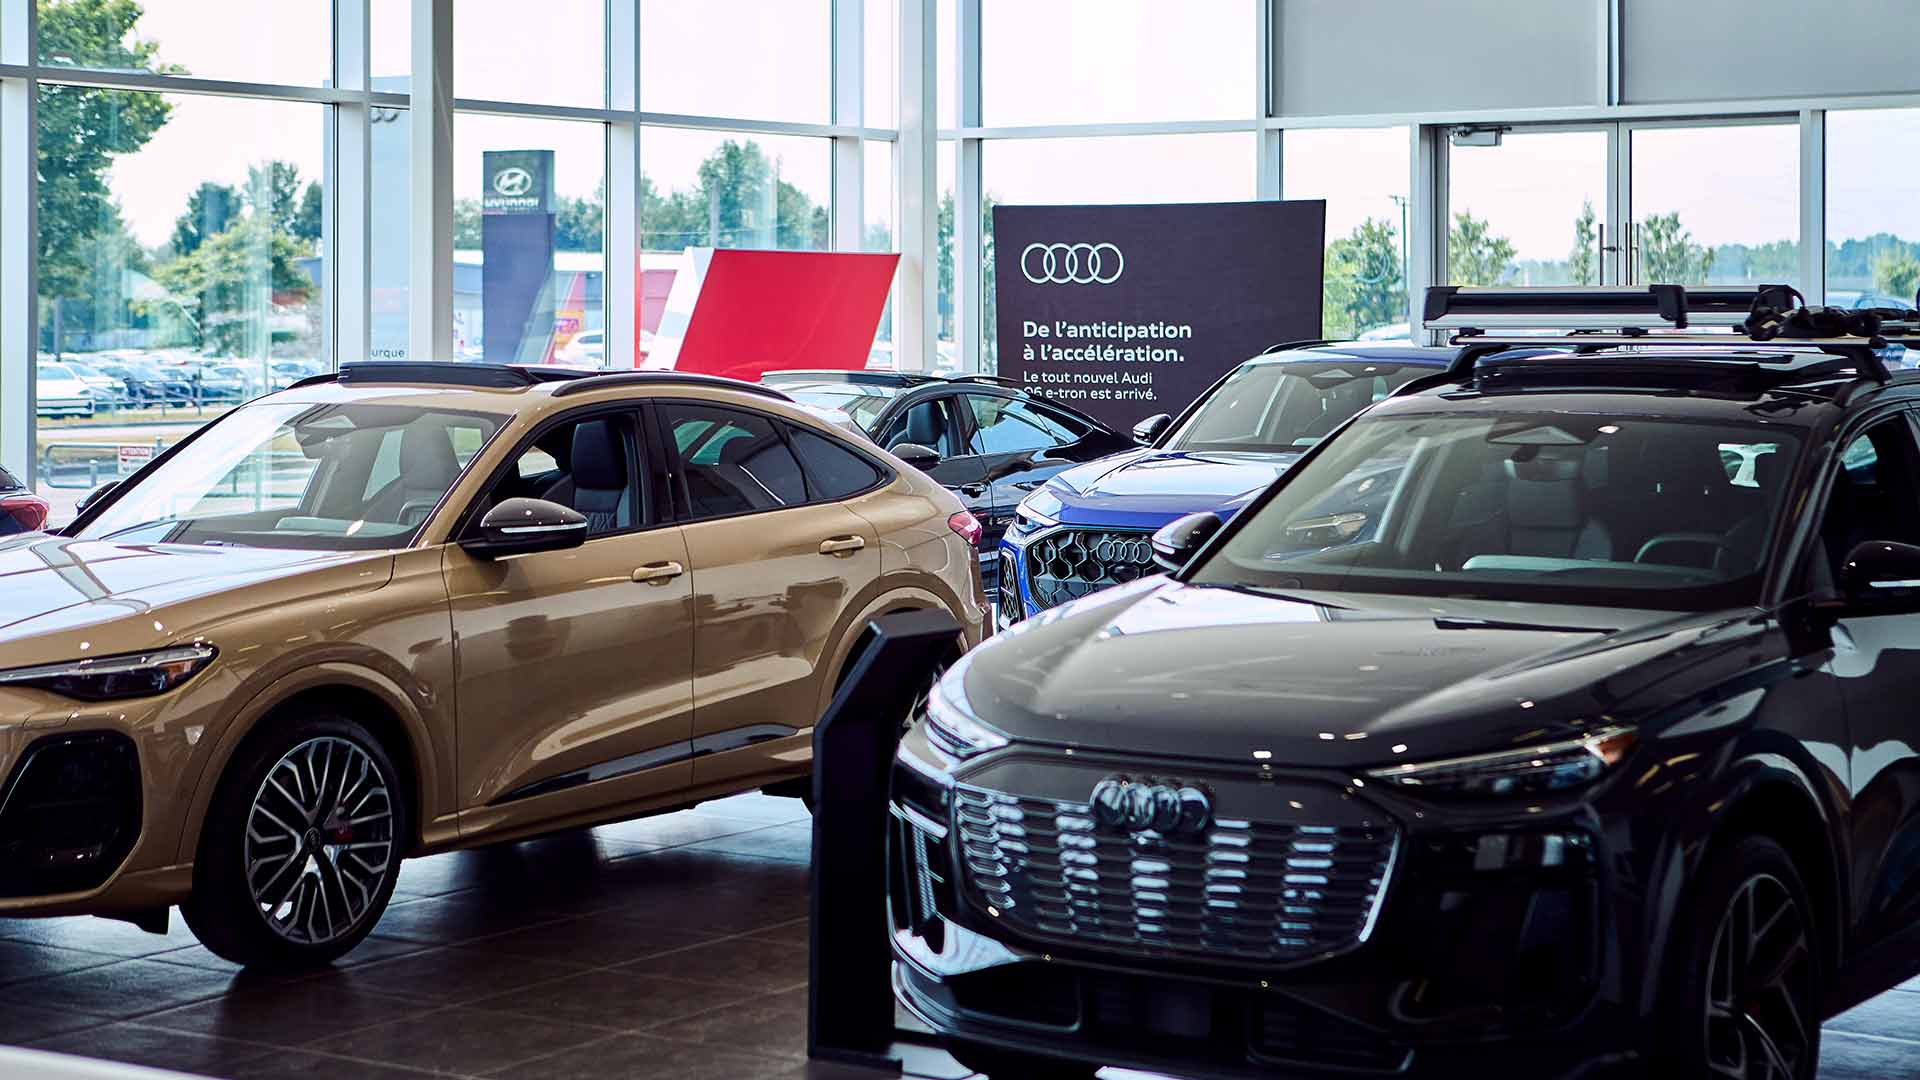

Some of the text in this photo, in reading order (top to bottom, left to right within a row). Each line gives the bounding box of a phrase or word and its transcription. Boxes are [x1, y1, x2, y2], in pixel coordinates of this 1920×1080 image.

[1023, 321, 1192, 342] De l'anticipation
[1023, 344, 1185, 362] à l'accélération.
[1023, 371, 1153, 384] Le tout nouvel Audi
[1045, 388, 1087, 399] e-tron
[1090, 389, 1112, 400] est
[1114, 387, 1158, 400] arrivé.
